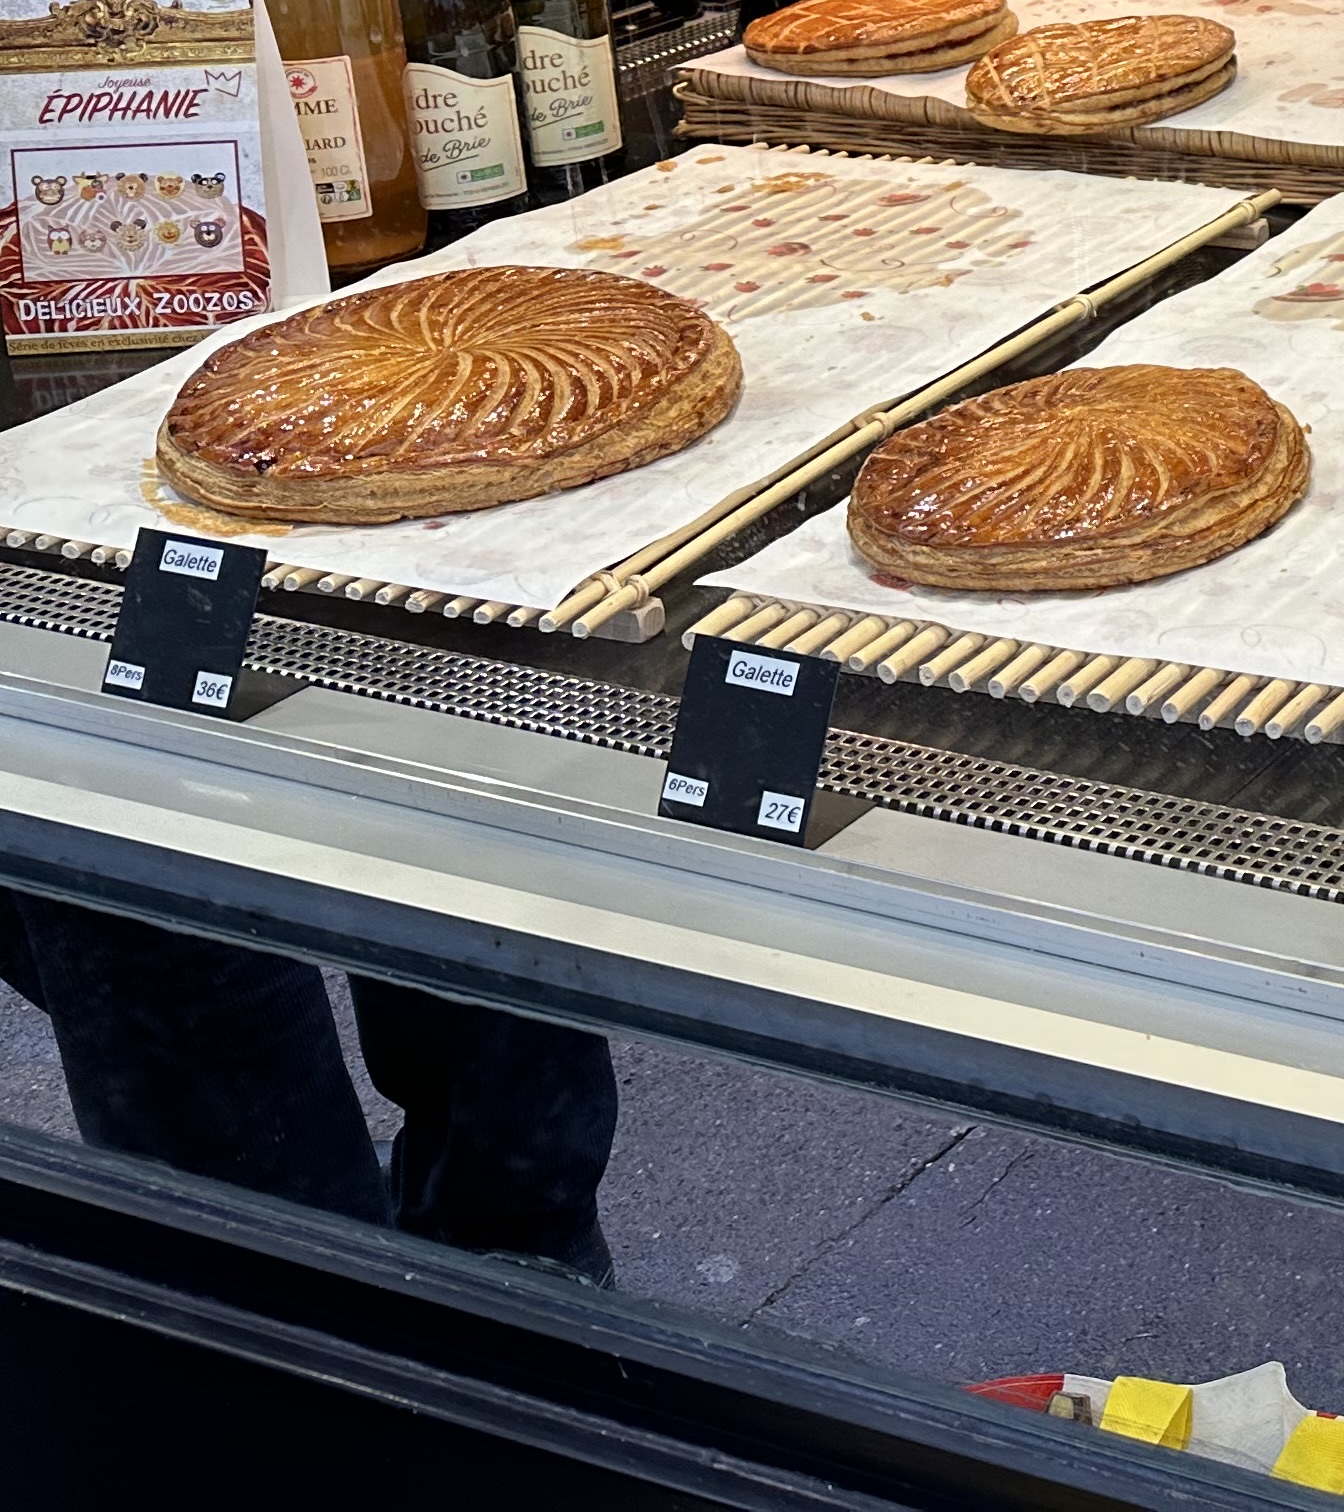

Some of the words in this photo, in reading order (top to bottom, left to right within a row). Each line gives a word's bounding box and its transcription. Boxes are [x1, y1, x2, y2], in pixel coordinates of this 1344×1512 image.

[523, 50, 564, 70] dre
[99, 76, 151, 94] Joyeuse
[39, 89, 208, 124] ÉPIPHANIE
[414, 88, 459, 111] dre
[549, 94, 594, 118] Brie
[305, 136, 347, 151] IARD
[421, 148, 440, 164] de
[443, 138, 492, 160] Brie
[152, 291, 255, 315] ZOOZOS
[9, 339, 39, 353] Série
[40, 339, 54, 351] de
[90, 339, 106, 349] en
[107, 334, 171, 349] exclusivité
[163, 545, 218, 575] Galette
[110, 662, 143, 683] 8Pers
[731, 659, 796, 690] Galette
[196, 679, 228, 703] 36€
[667, 777, 706, 799] 6Pers
[765, 801, 801, 825] 27€
